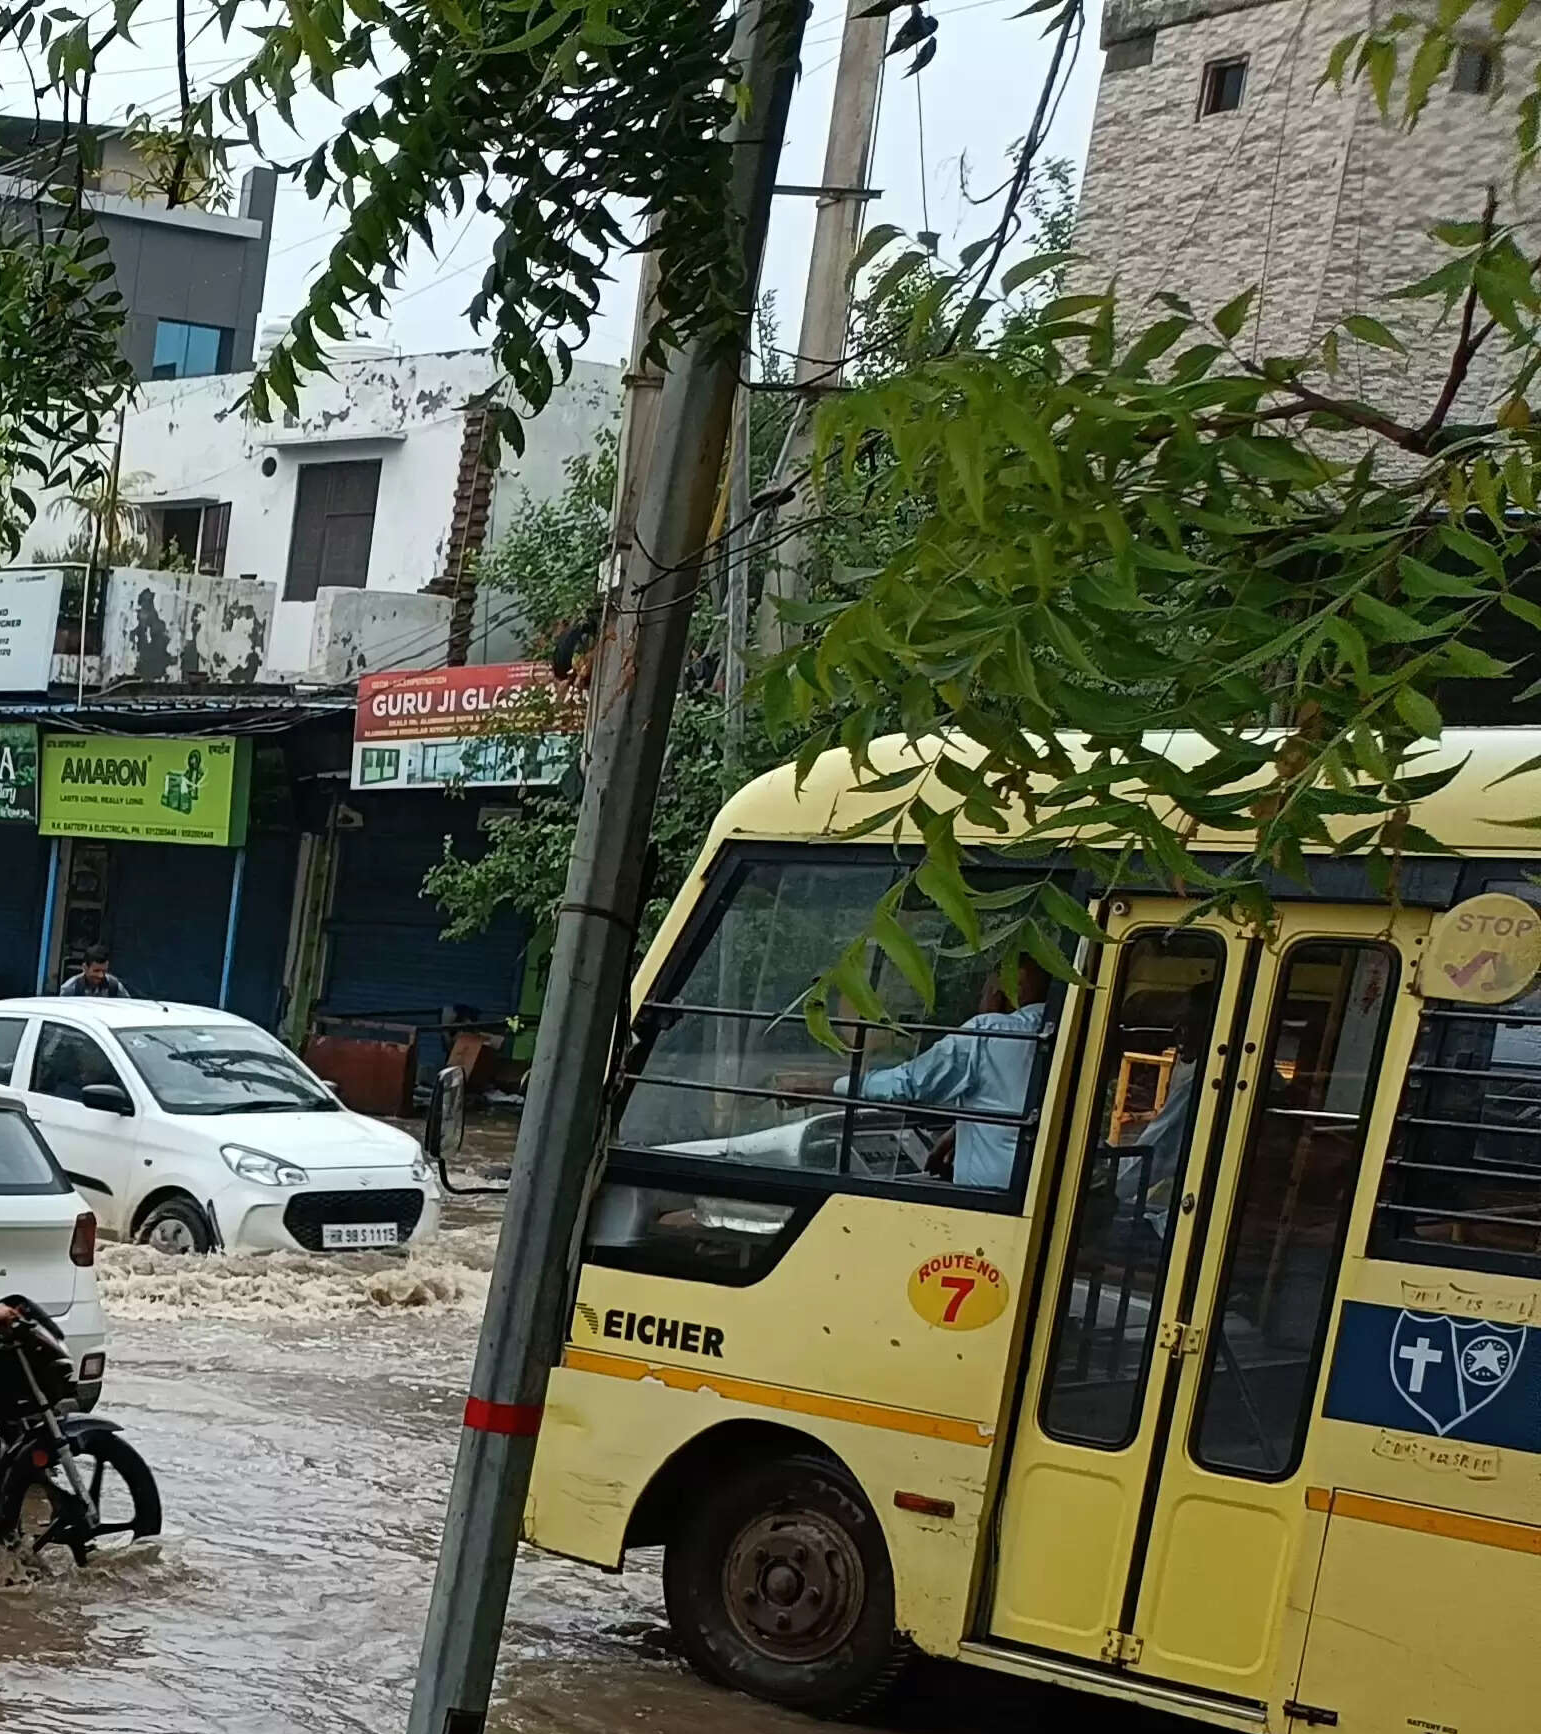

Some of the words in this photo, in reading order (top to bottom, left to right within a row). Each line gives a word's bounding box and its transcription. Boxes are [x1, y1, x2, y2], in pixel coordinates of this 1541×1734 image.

[372, 691, 433, 717] GURU
[436, 689, 457, 713] JI
[60, 756, 147, 787] AMARON
[63, 822, 88, 832] BATTERY
[1457, 913, 1533, 937] STOP
[939, 1276, 975, 1323] 7
[603, 1309, 725, 1359] EICHER
[1407, 1718, 1441, 1731] BATTERY
